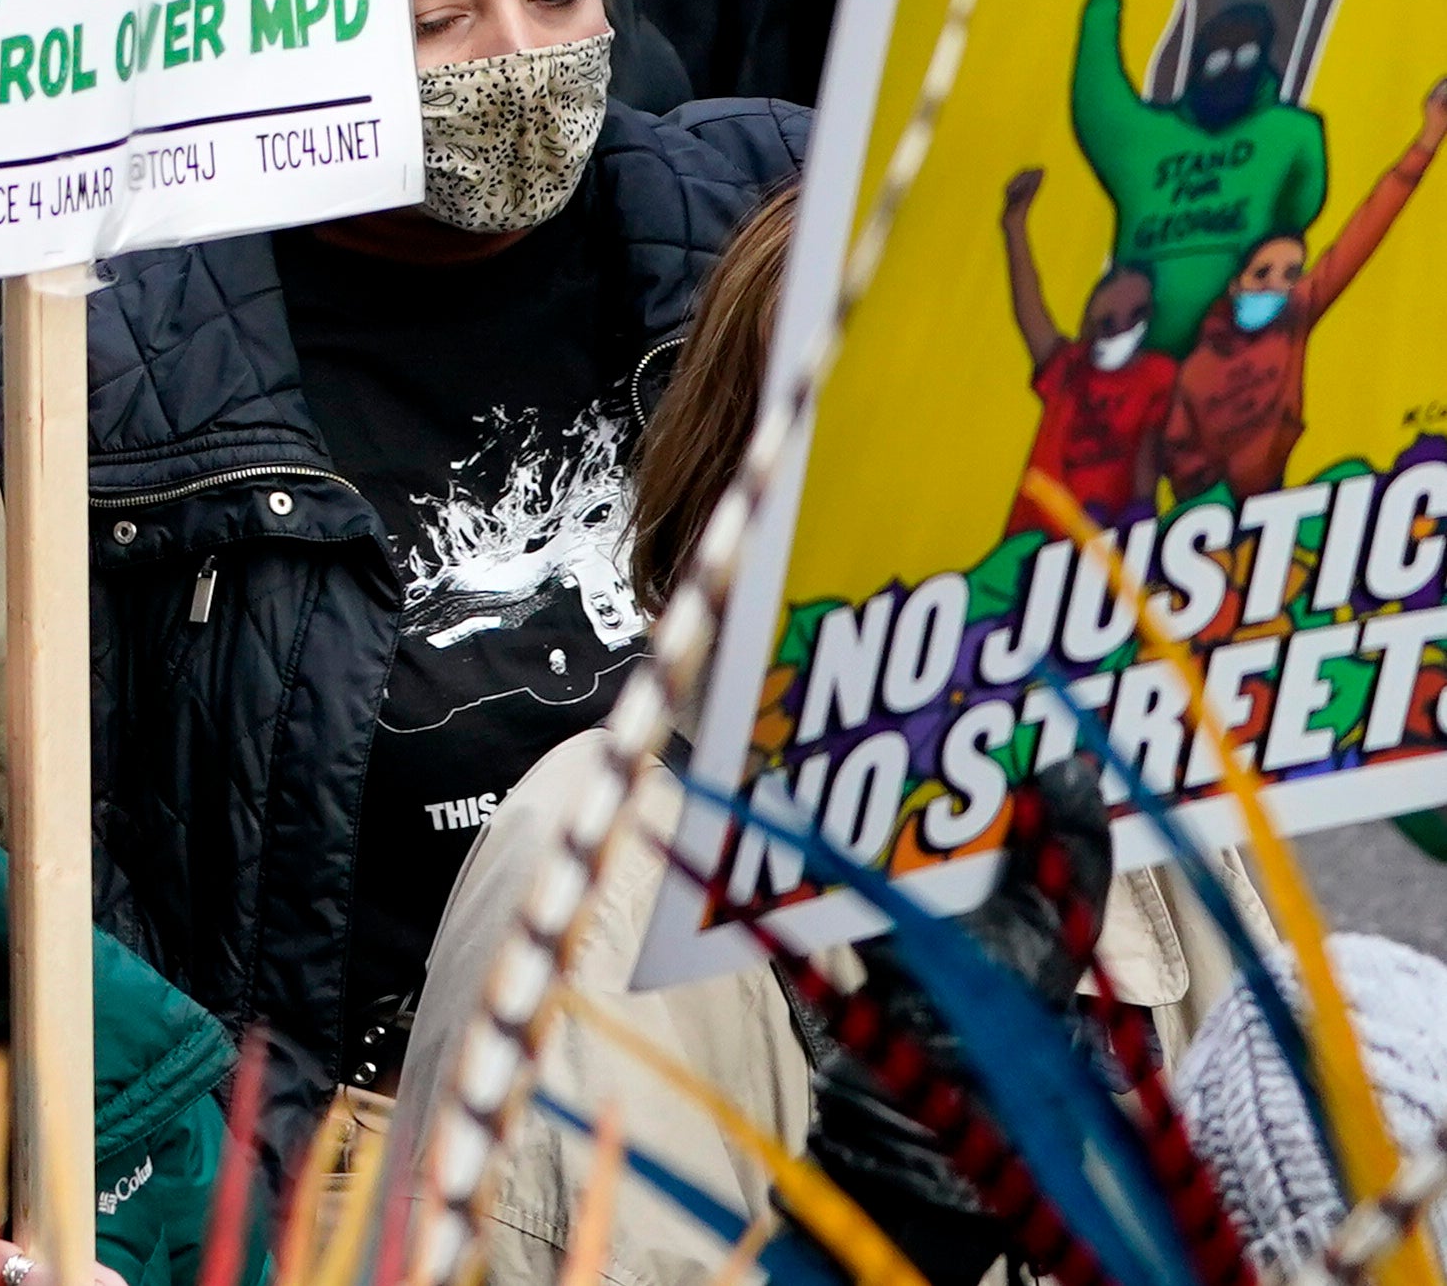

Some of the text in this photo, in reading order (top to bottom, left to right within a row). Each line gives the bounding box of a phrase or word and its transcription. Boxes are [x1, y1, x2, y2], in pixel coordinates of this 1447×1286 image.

[28, 181, 44, 222] 4
[49, 166, 115, 217] JAMAR
[256, 119, 383, 175] TCC4J.NET
[797, 571, 970, 745] NO
[425, 800, 498, 831] THIS
[728, 607, 1447, 905] NO STREET
